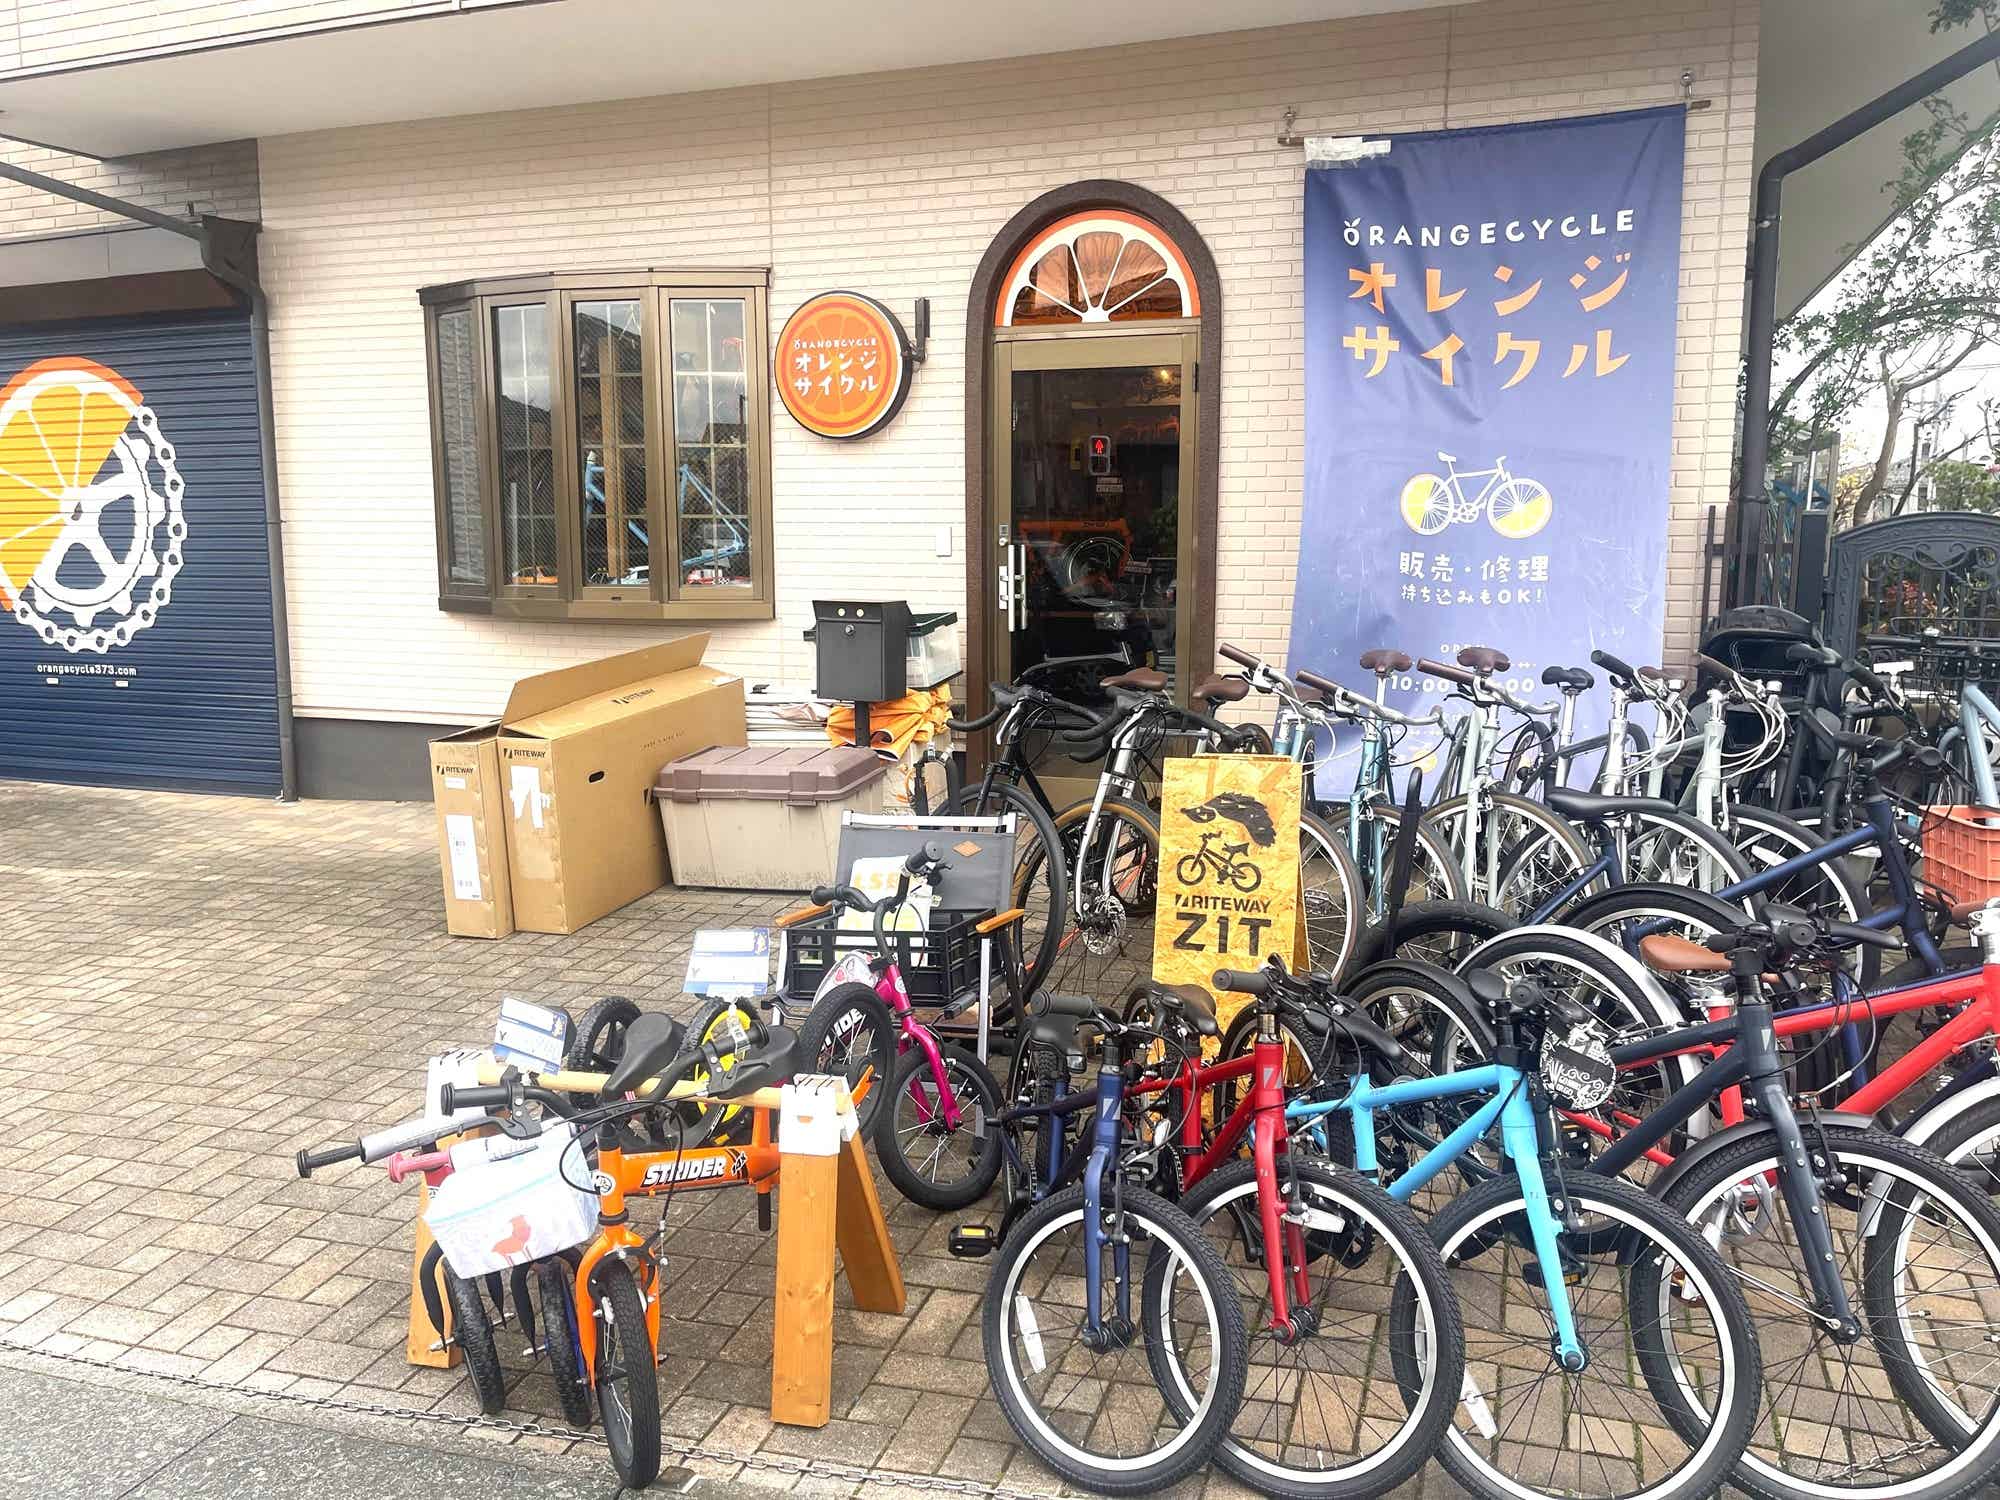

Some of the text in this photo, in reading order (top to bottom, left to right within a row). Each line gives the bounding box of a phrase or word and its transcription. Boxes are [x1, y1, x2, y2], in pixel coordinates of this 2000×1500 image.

[1343, 209, 1634, 247] ORANGECYCLE
[1348, 252, 1631, 316] オレンジ
[795, 351, 876, 373] オレンジ
[1342, 325, 1632, 391] サイクル
[794, 375, 879, 397] サイクル
[1399, 551, 1549, 583] 販売・修理
[37, 664, 137, 676] orangecycle373.com
[514, 749, 546, 759] RITEWAY
[1192, 895, 1271, 913] RITEWAY
[641, 1157, 727, 1187] STRIDER
